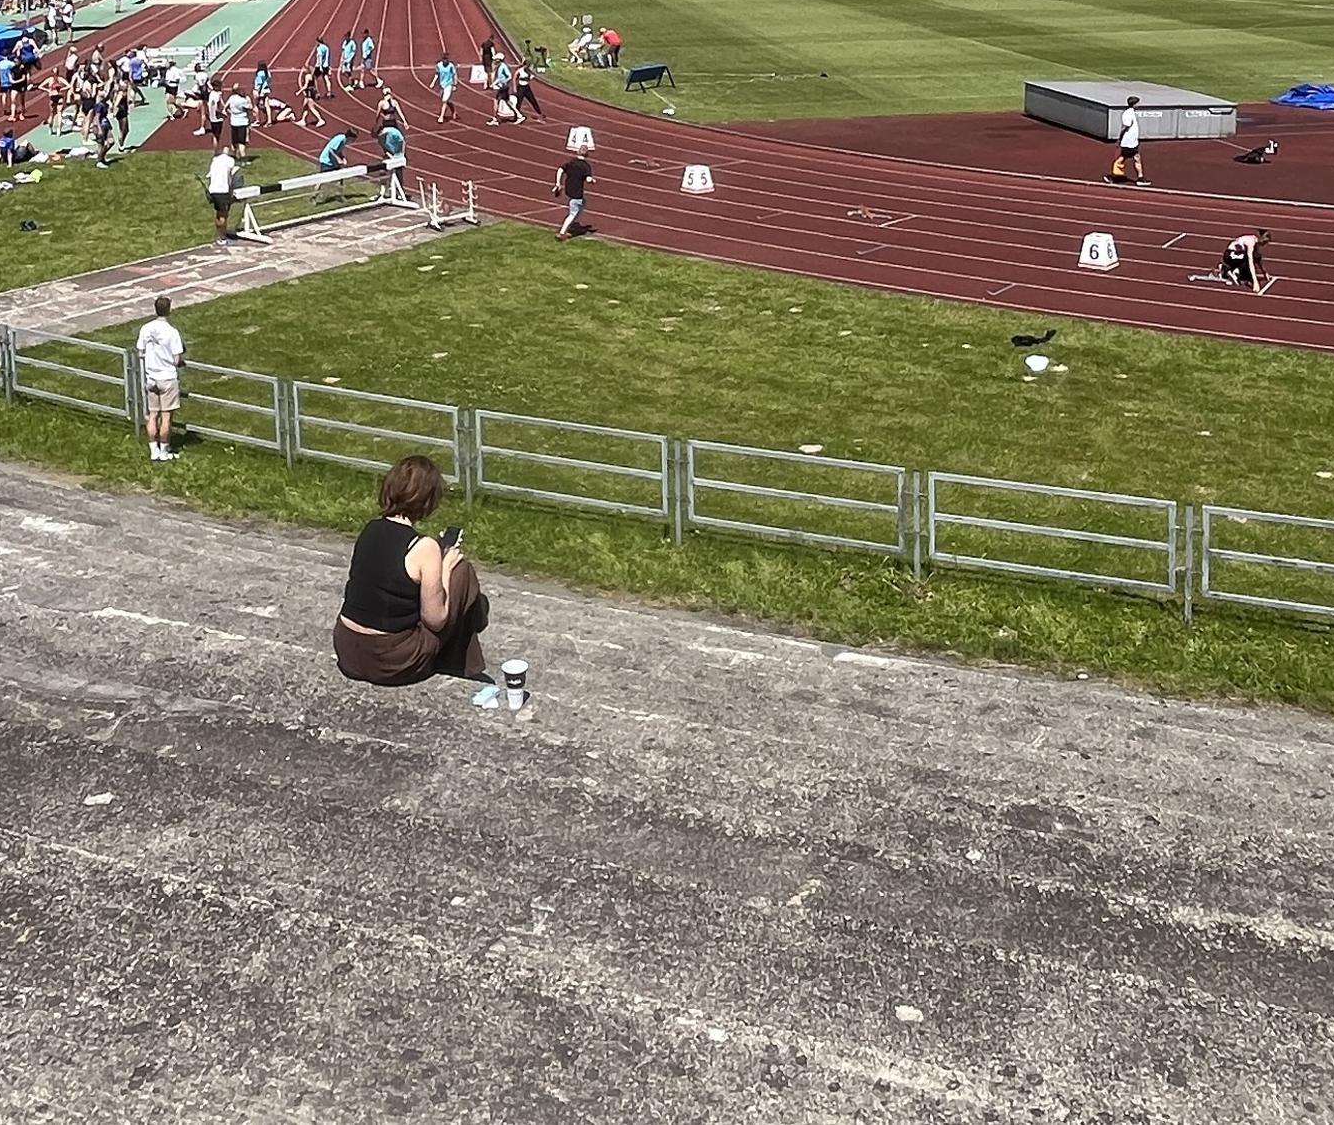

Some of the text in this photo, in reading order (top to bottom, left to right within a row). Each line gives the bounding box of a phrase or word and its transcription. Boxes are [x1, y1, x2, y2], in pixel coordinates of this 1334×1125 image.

[687, 173, 694, 186] 5
[700, 172, 708, 186] 5
[1089, 244, 1099, 260] 6
[1107, 242, 1113, 260] 6
